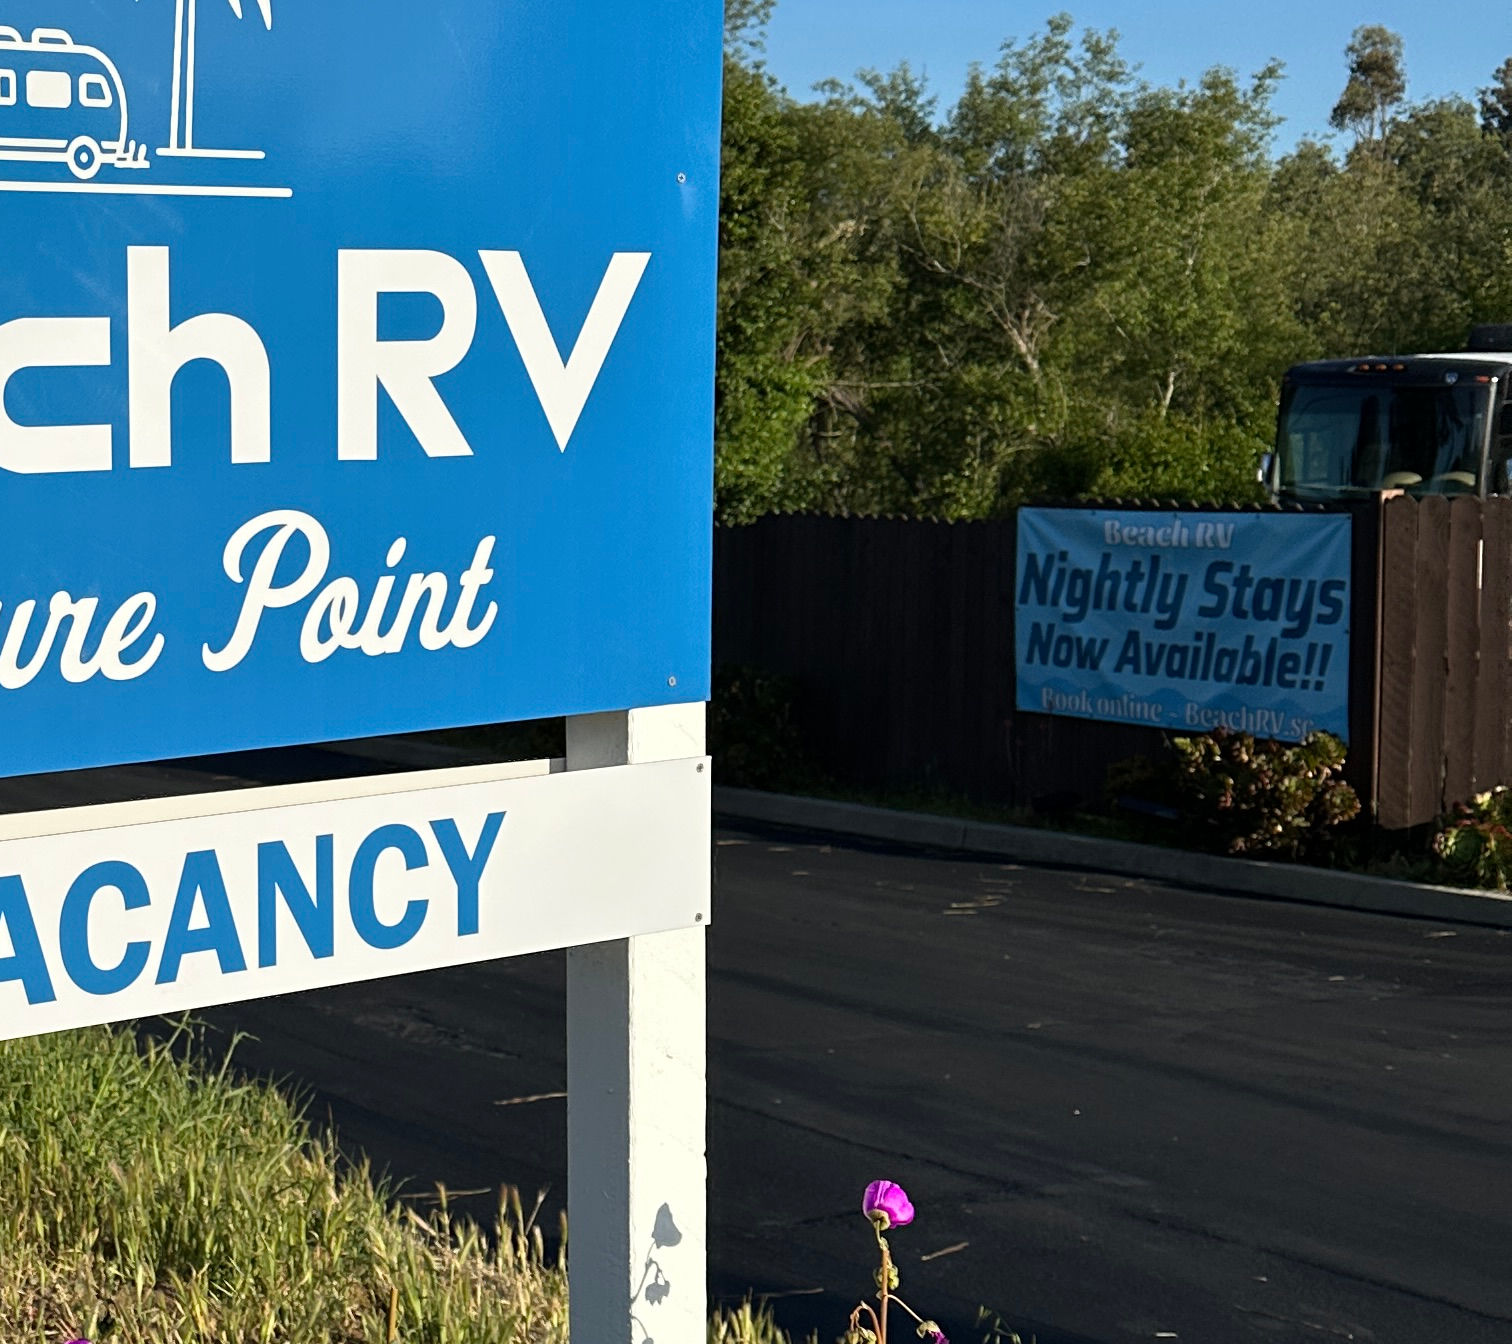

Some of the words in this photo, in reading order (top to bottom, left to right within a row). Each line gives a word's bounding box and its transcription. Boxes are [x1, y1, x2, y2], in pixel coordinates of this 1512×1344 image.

[338, 249, 652, 461] RV
[1103, 519, 1189, 548] Beach
[1195, 522, 1236, 549] RV
[202, 509, 498, 672] Point
[1018, 550, 1188, 631] Nightly
[1197, 560, 1347, 639] Stays
[1025, 621, 1110, 671] Now
[1114, 630, 1333, 692] Available!!
[1040, 686, 1094, 714] Book
[1095, 693, 1163, 722] online
